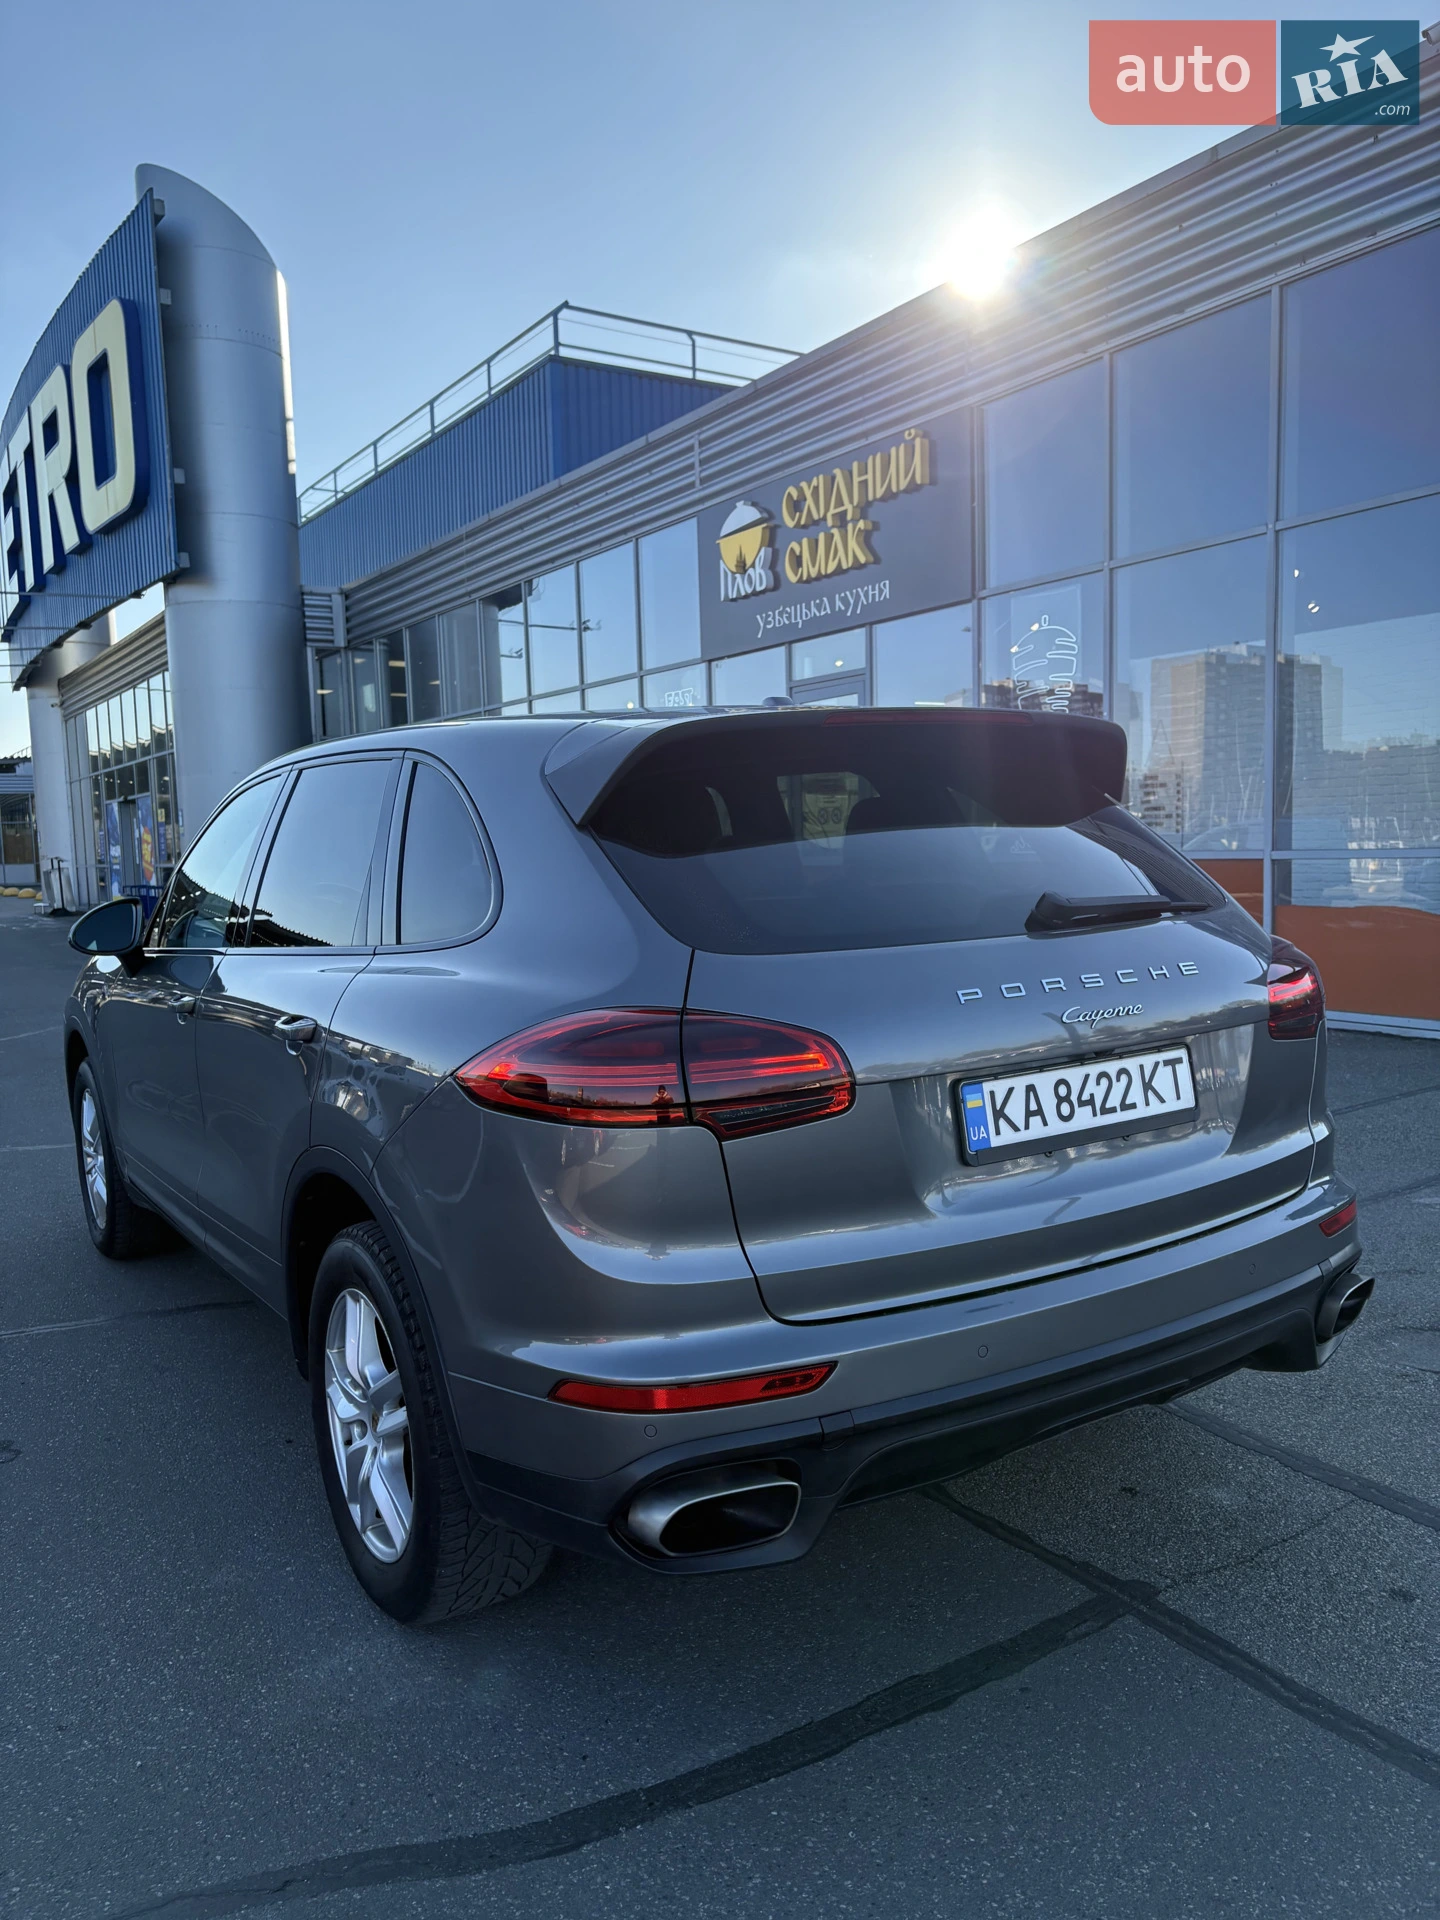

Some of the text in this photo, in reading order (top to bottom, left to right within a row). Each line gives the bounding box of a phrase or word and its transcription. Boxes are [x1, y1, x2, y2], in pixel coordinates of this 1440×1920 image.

[0, 298, 136, 638] ETRO
[782, 428, 930, 528] СХІДНИЙ
[785, 519, 874, 584] СМАК
[956, 961, 1199, 1004] PORSCHE
[1061, 1003, 1144, 1029] Cayenne
[970, 1125, 988, 1141] UA
